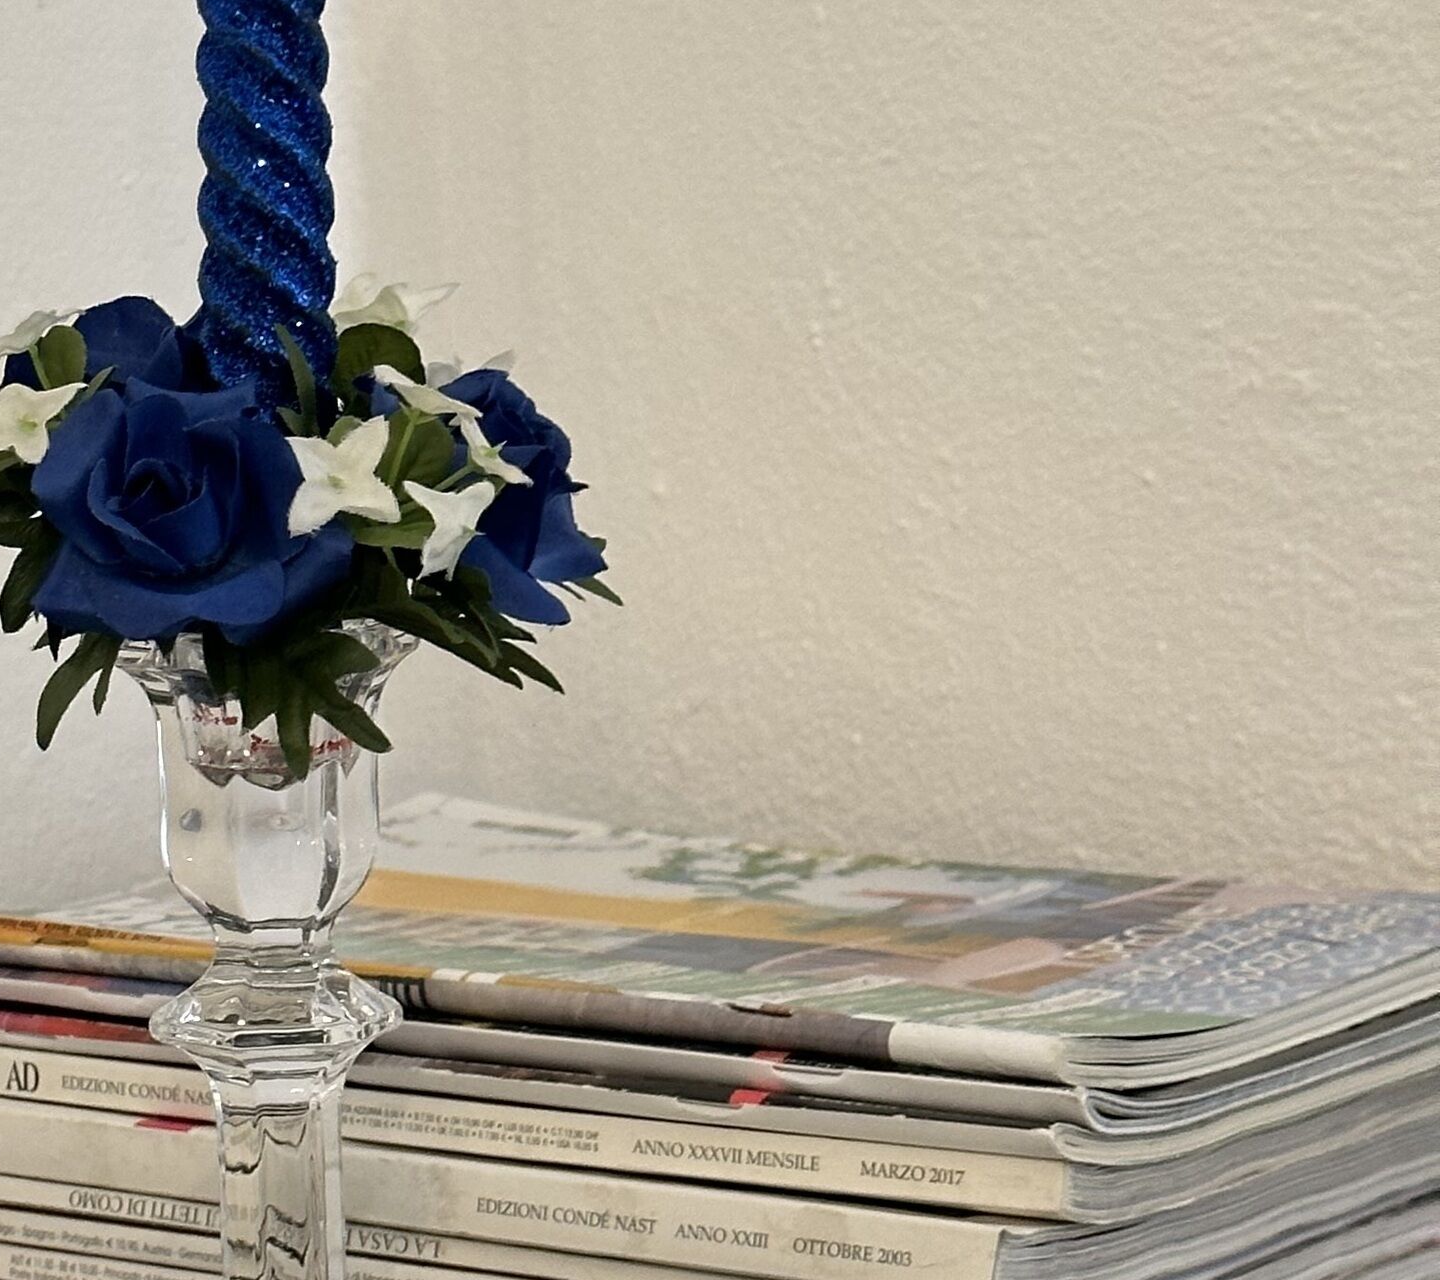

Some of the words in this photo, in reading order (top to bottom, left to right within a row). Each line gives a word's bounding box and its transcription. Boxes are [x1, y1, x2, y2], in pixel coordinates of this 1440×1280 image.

[6, 1059, 40, 1092] AD
[61, 1073, 126, 1097] EDIZIONI
[128, 1077, 181, 1103] CONDÉ
[183, 1088, 213, 1108] NAS
[631, 1137, 685, 1162] ANNO
[686, 1141, 744, 1166] XXXVII
[745, 1146, 821, 1172] MENSILE
[860, 1159, 926, 1185] MARZO
[928, 1166, 966, 1187] 2017
[68, 1188, 123, 1215] COMO
[126, 1196, 145, 1217] DI
[151, 1199, 204, 1225] TETTI
[358, 1229, 409, 1254] CASA
[475, 1196, 549, 1222] EDIZIONI
[551, 1201, 611, 1230] CONDÉ
[613, 1211, 657, 1236] NAST
[674, 1221, 728, 1248] ANNO
[729, 1227, 770, 1250] XXIII
[792, 1235, 873, 1264] OTTOBRE
[876, 1244, 913, 1268] 2003
[414, 1234, 441, 1259] LA
